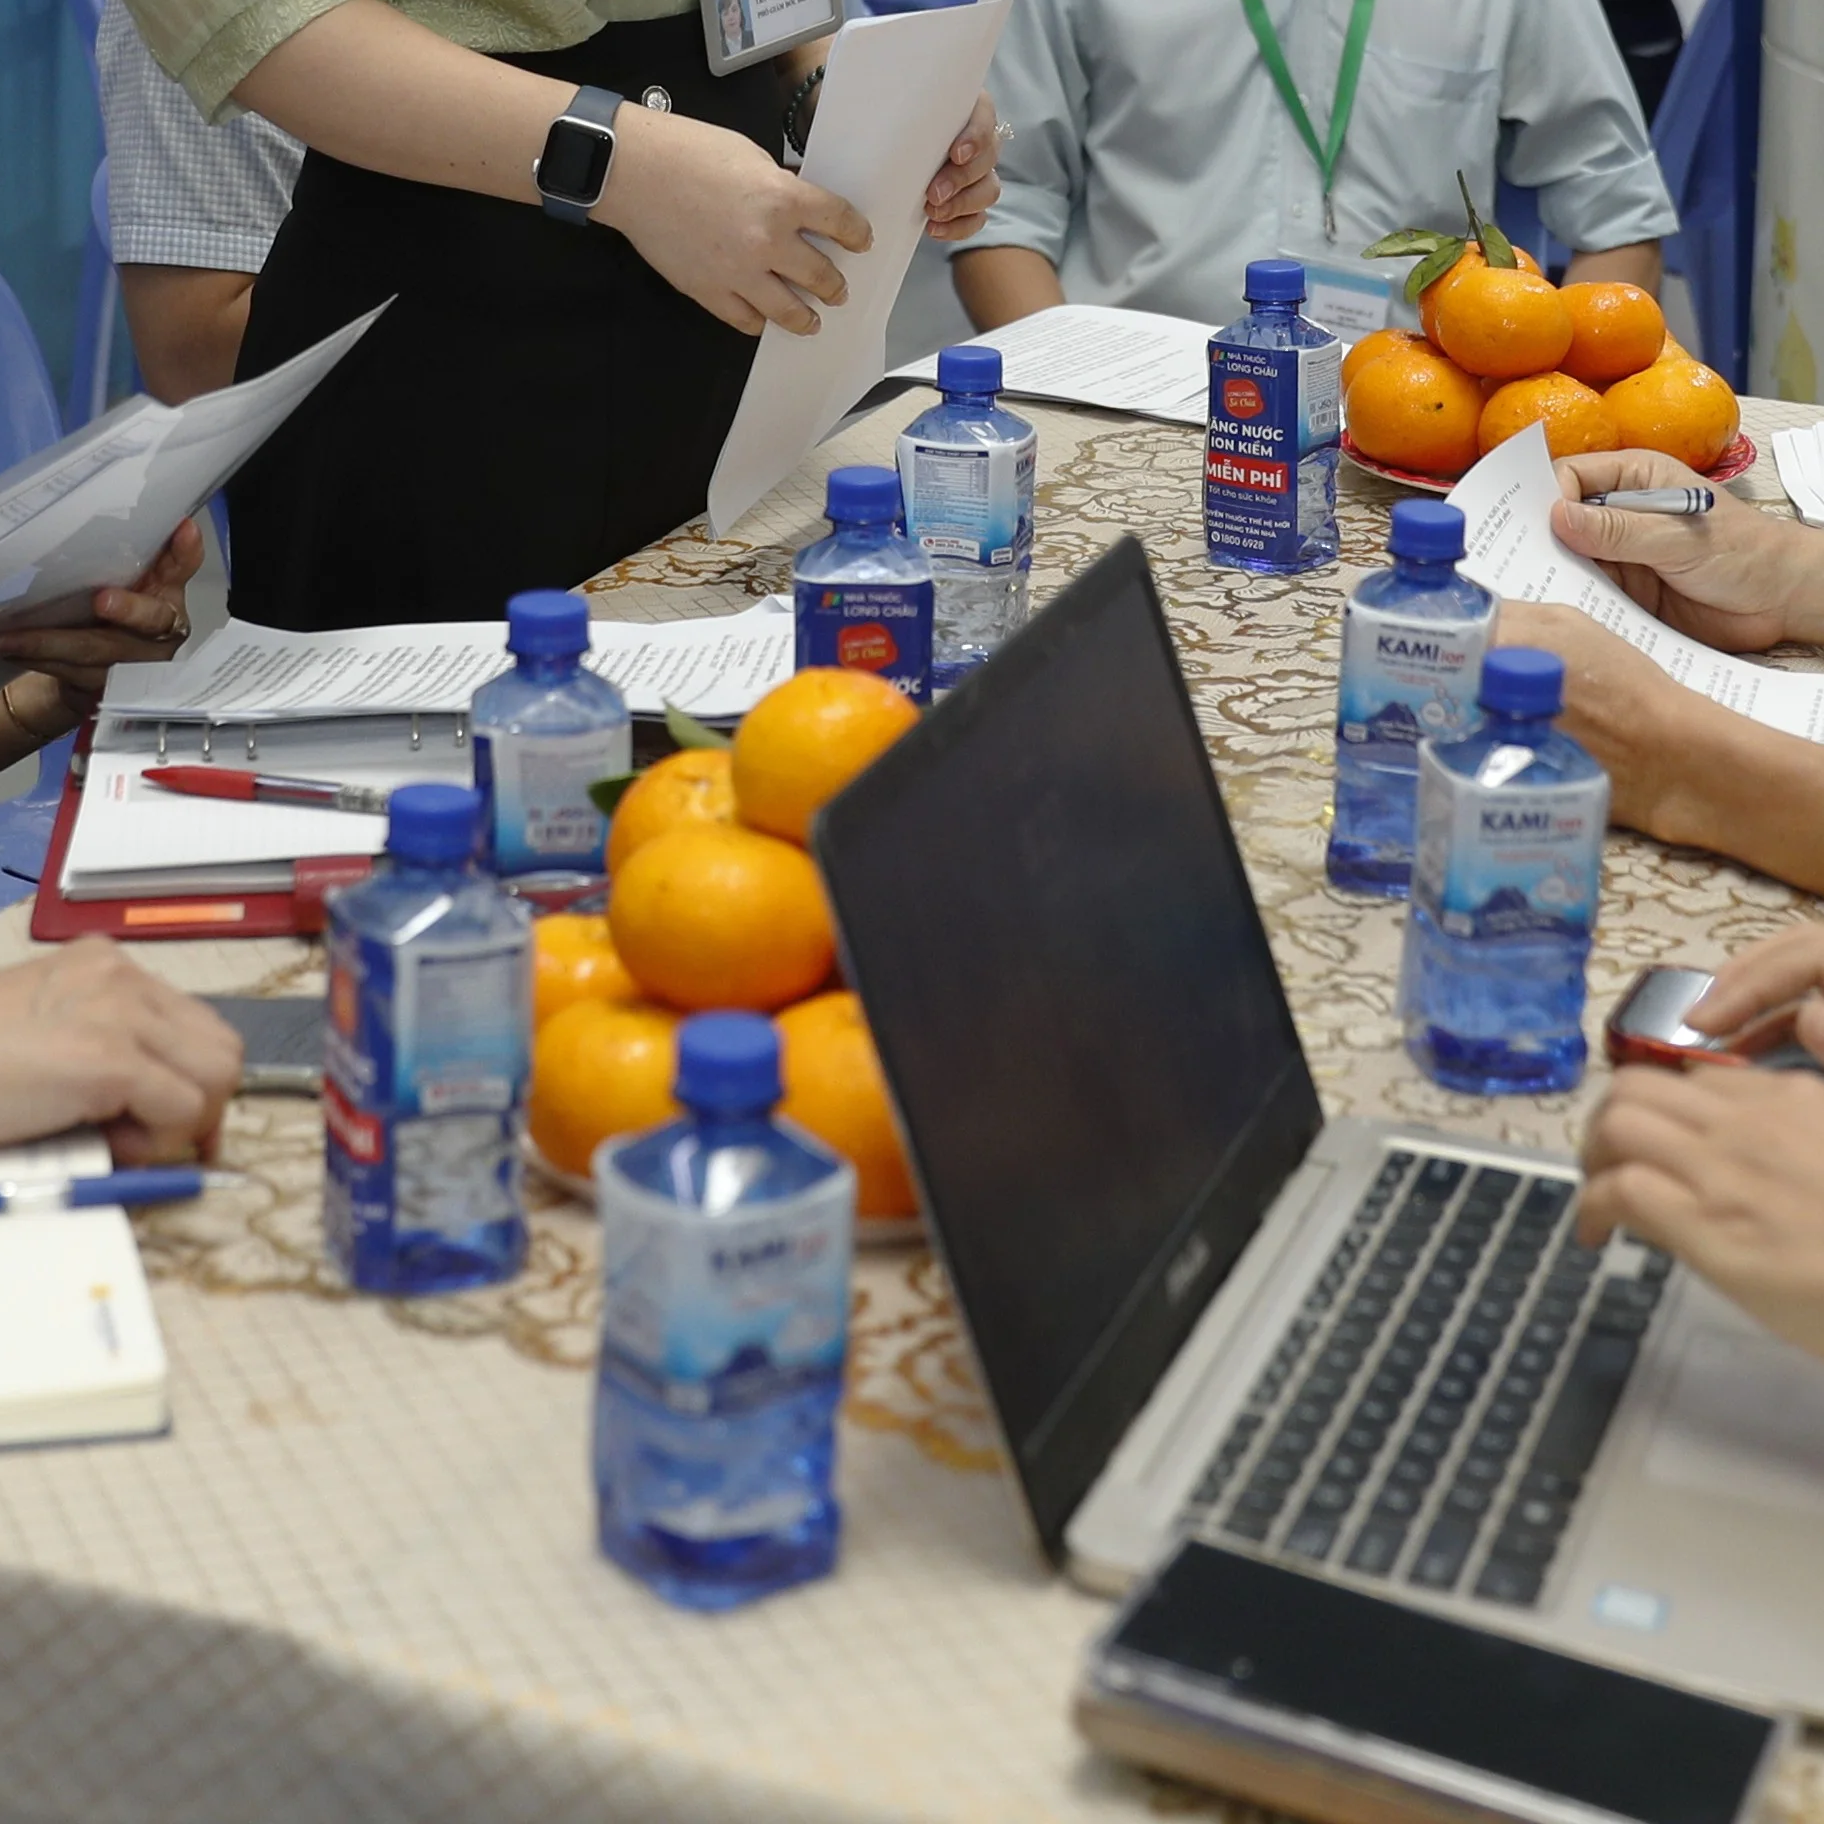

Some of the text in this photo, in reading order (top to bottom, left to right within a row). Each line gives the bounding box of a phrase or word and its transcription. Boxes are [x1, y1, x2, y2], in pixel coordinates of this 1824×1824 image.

[1227, 362, 1278, 377] LONG CHÂU
[1209, 416, 1284, 441] ẶNG NƯỚC
[1211, 437, 1234, 451] ION
[1206, 458, 1283, 489] MIỄN PHÍ
[1222, 487, 1236, 498] cho
[1221, 534, 1264, 550] 1800 6928
[1378, 636, 1439, 661] KAMI
[1481, 812, 1550, 832] KAMI
